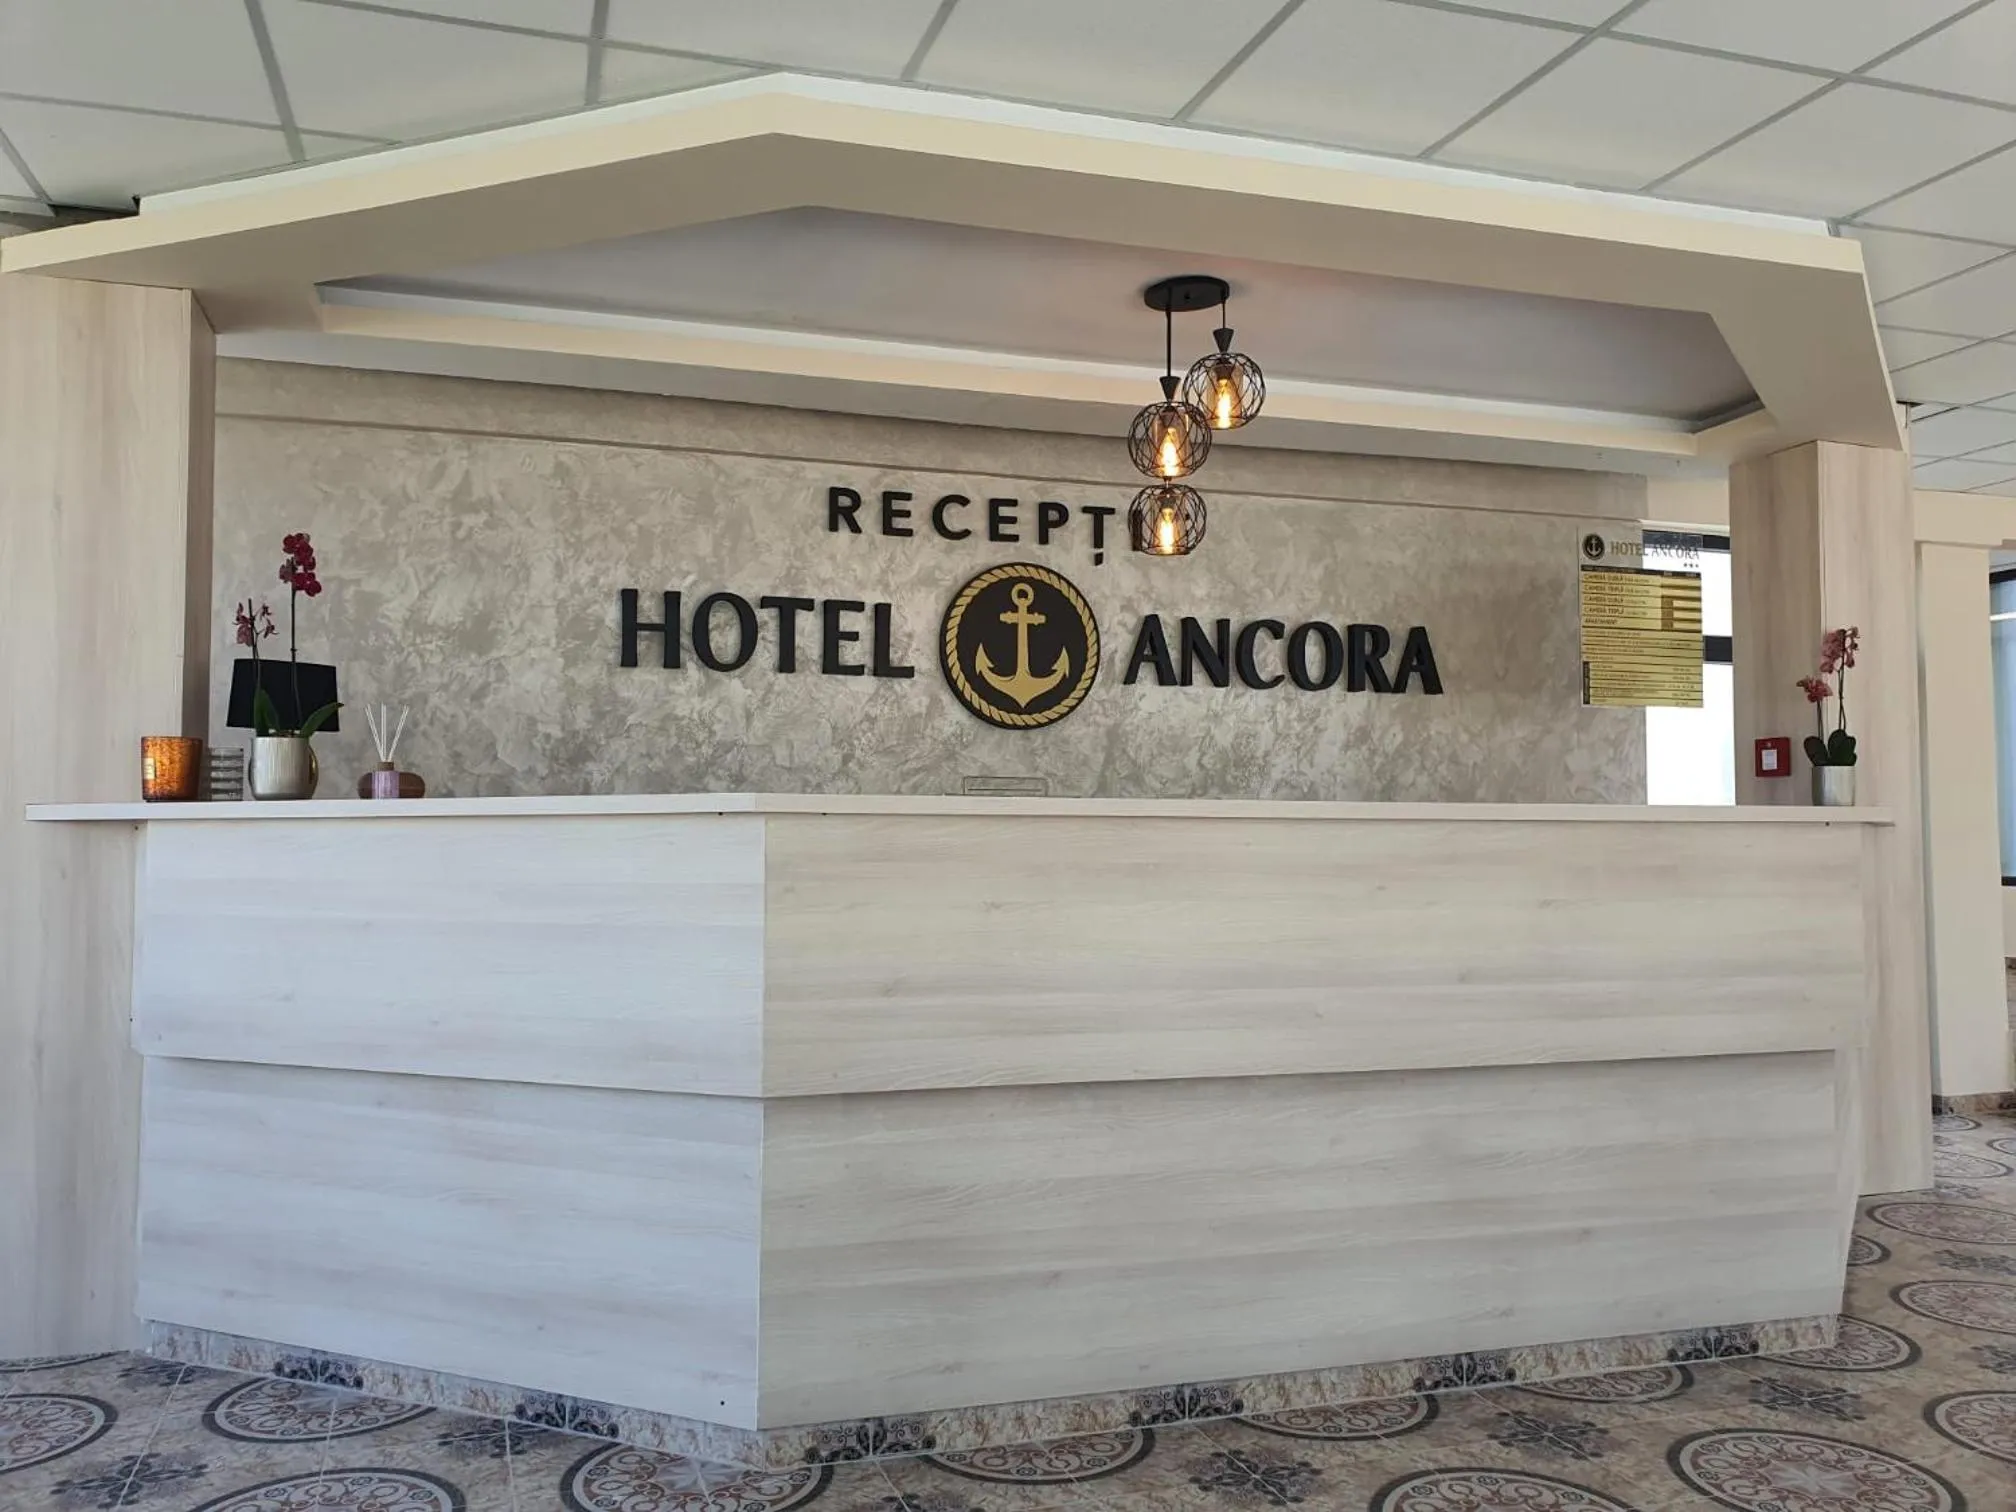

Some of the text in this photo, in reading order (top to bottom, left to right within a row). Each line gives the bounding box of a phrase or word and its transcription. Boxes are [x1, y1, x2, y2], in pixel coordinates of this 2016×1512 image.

[1611, 541, 1699, 560] HOTEL ANCORA
[620, 588, 1443, 695] HOTEL ANCORA
